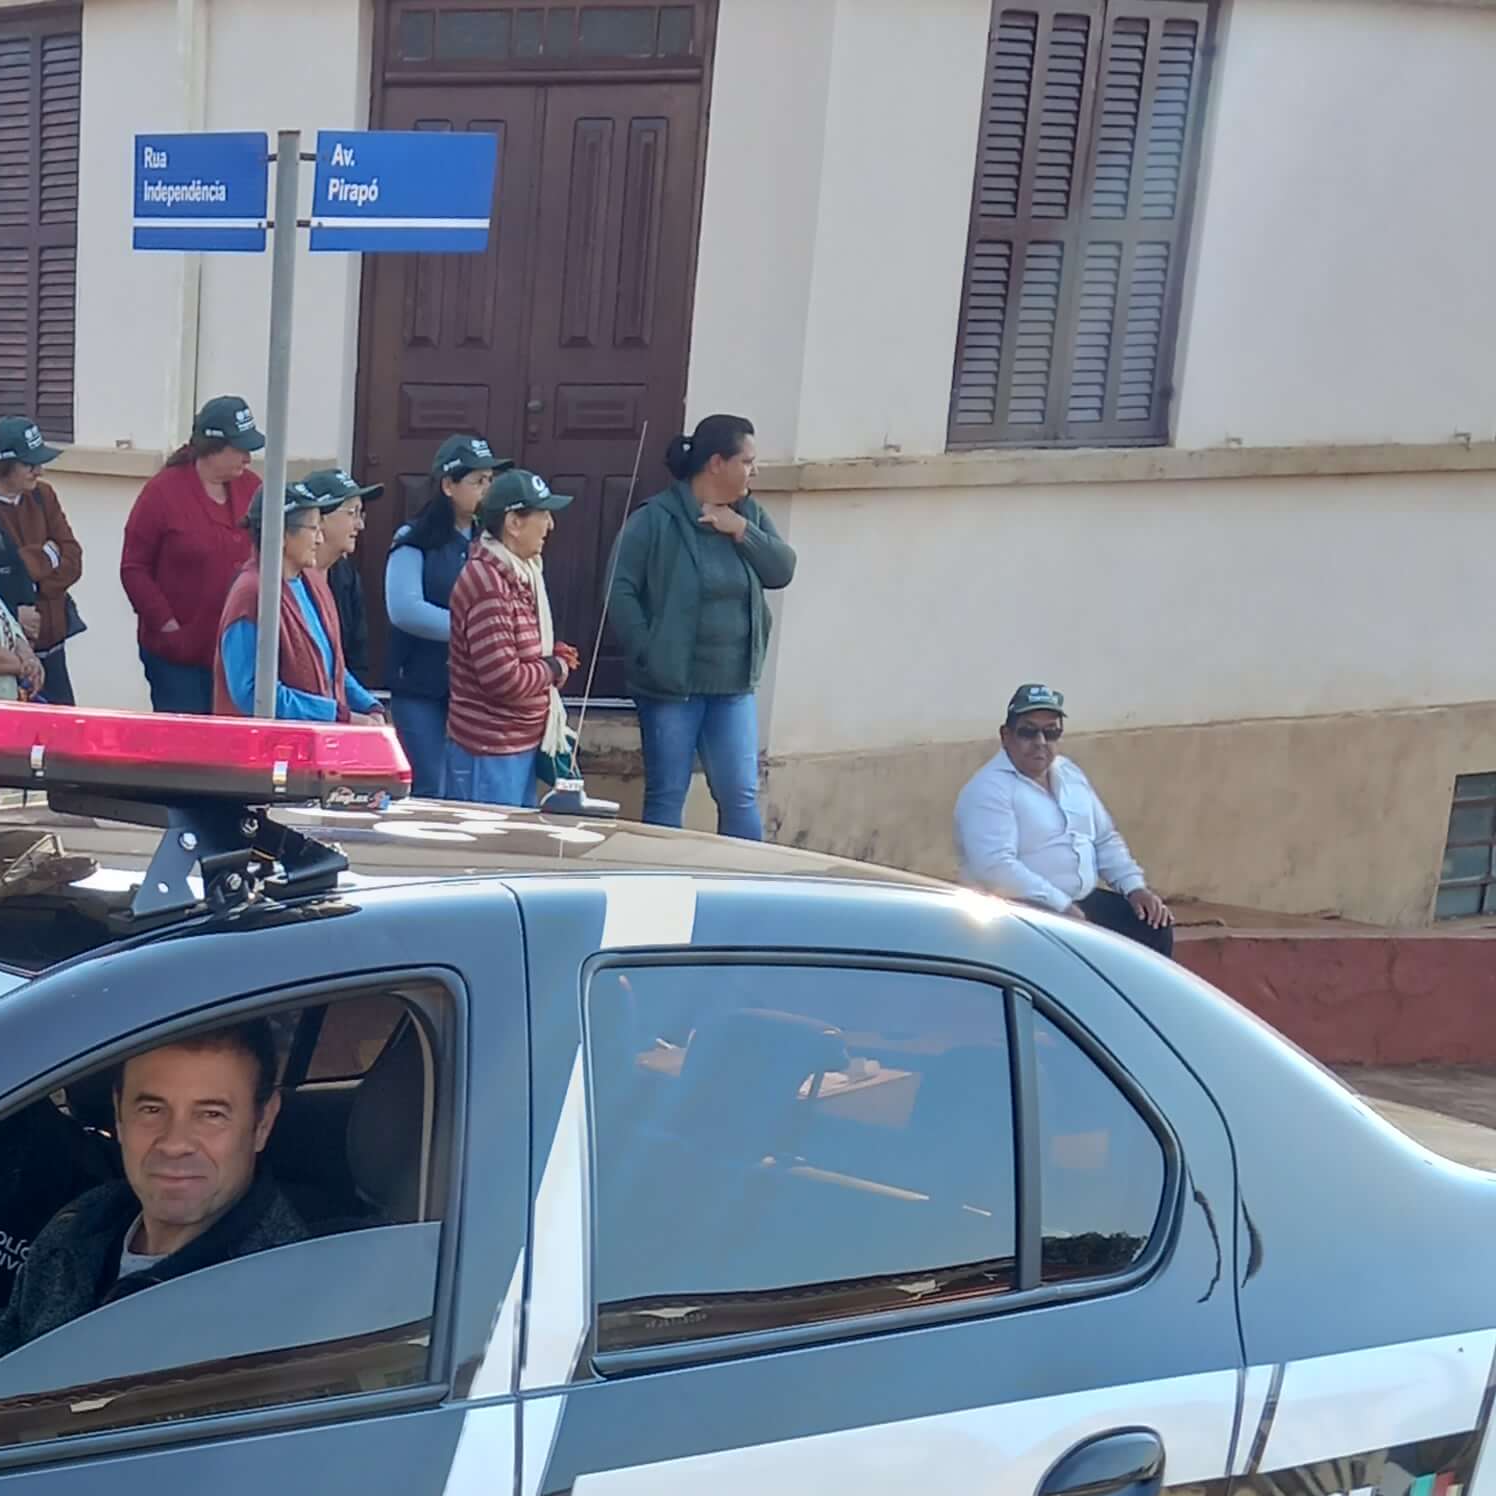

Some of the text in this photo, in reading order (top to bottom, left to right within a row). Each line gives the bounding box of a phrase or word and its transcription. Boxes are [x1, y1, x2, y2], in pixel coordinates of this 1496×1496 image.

[143, 146, 167, 169] Rua
[330, 143, 355, 167] Av.
[143, 179, 226, 207] Independência
[327, 178, 379, 207] Pirapó
